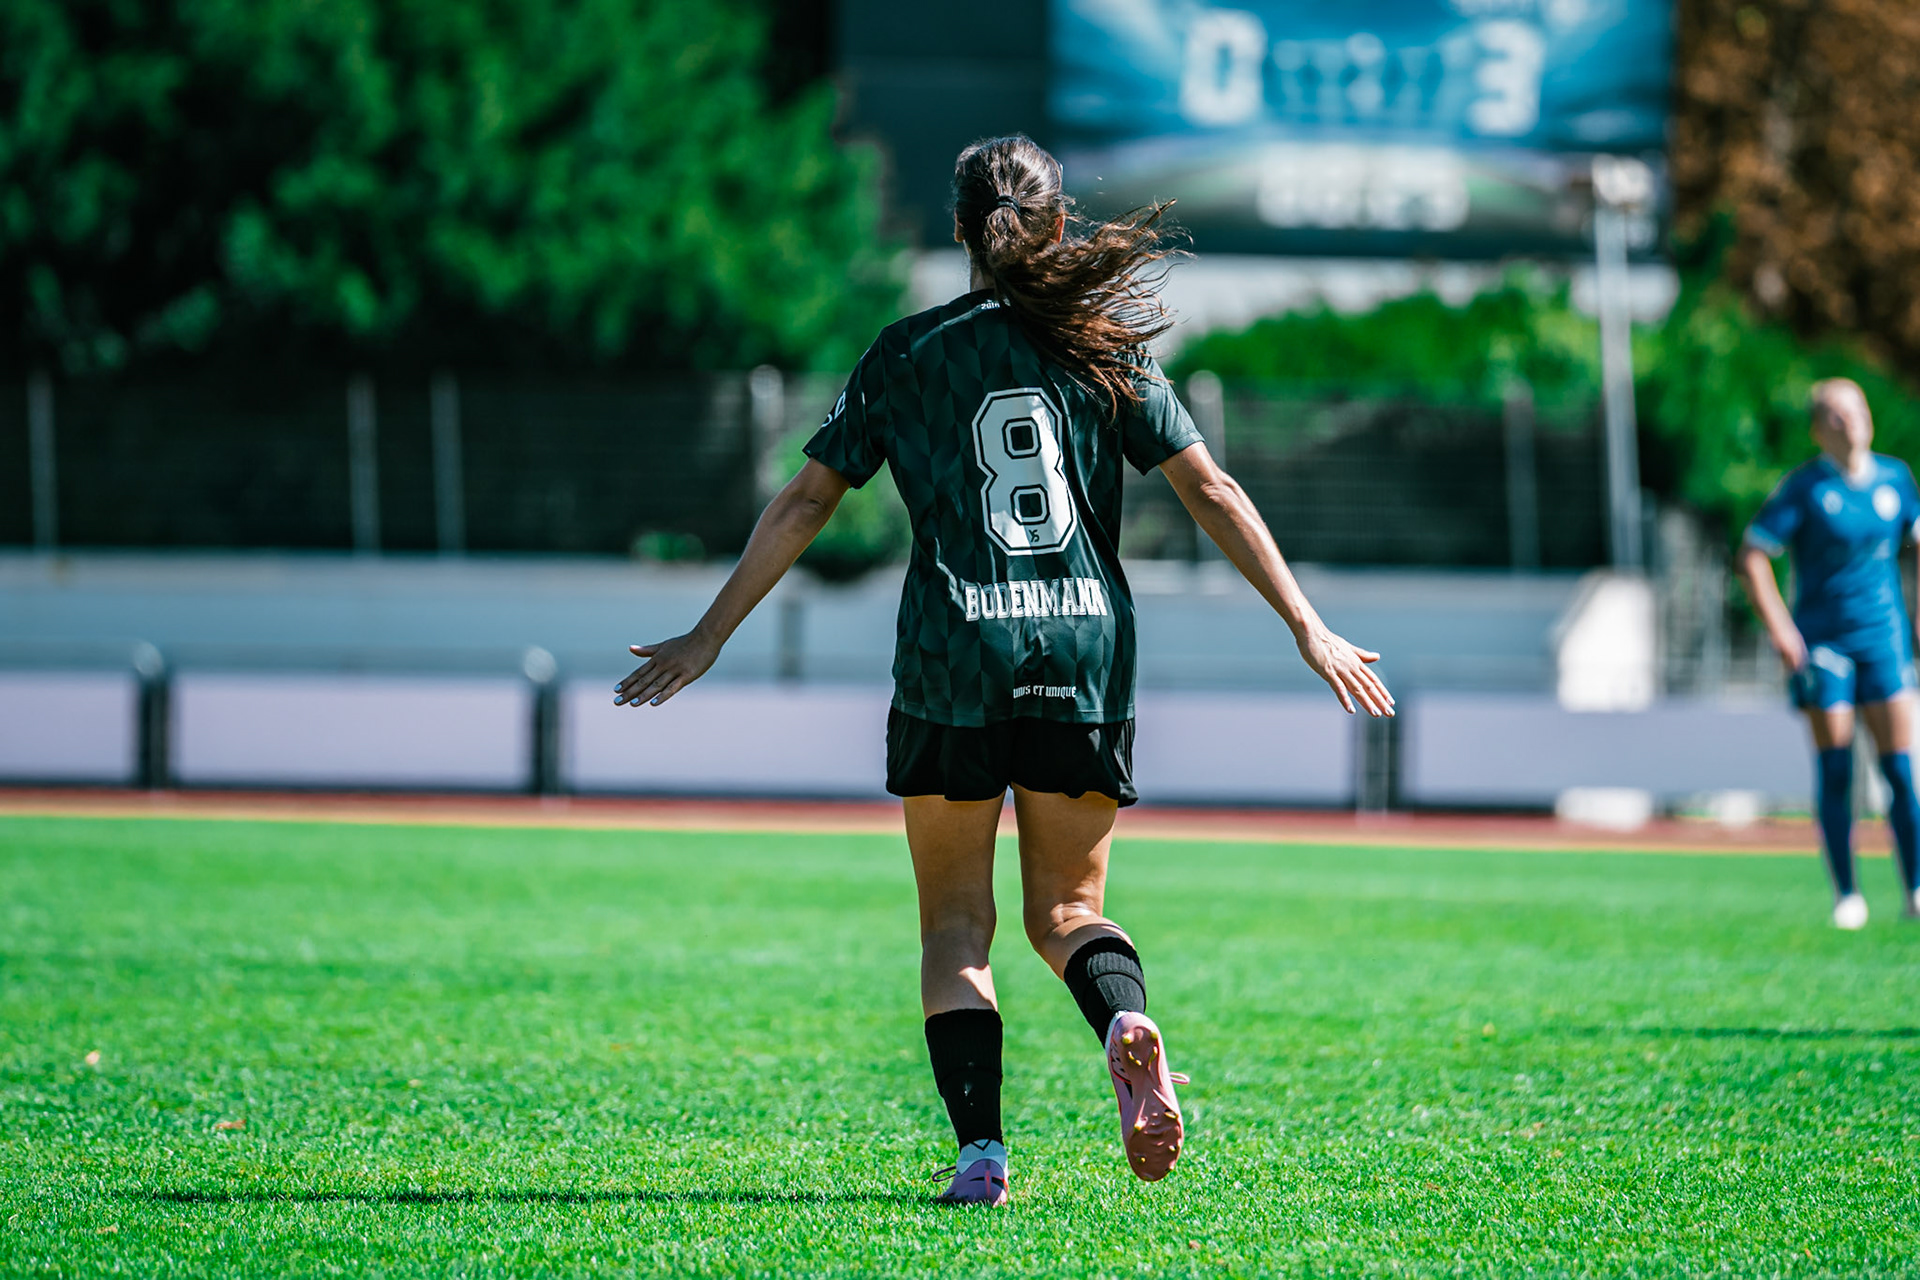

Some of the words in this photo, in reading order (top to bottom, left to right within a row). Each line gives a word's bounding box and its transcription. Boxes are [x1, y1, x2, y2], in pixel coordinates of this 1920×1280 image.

[1182, 10, 1267, 126] 0
[1465, 18, 1547, 137] 3
[972, 386, 1077, 556] 8
[965, 577, 1108, 622] BODENMANN
[1045, 685, 1077, 700] UNIQUE
